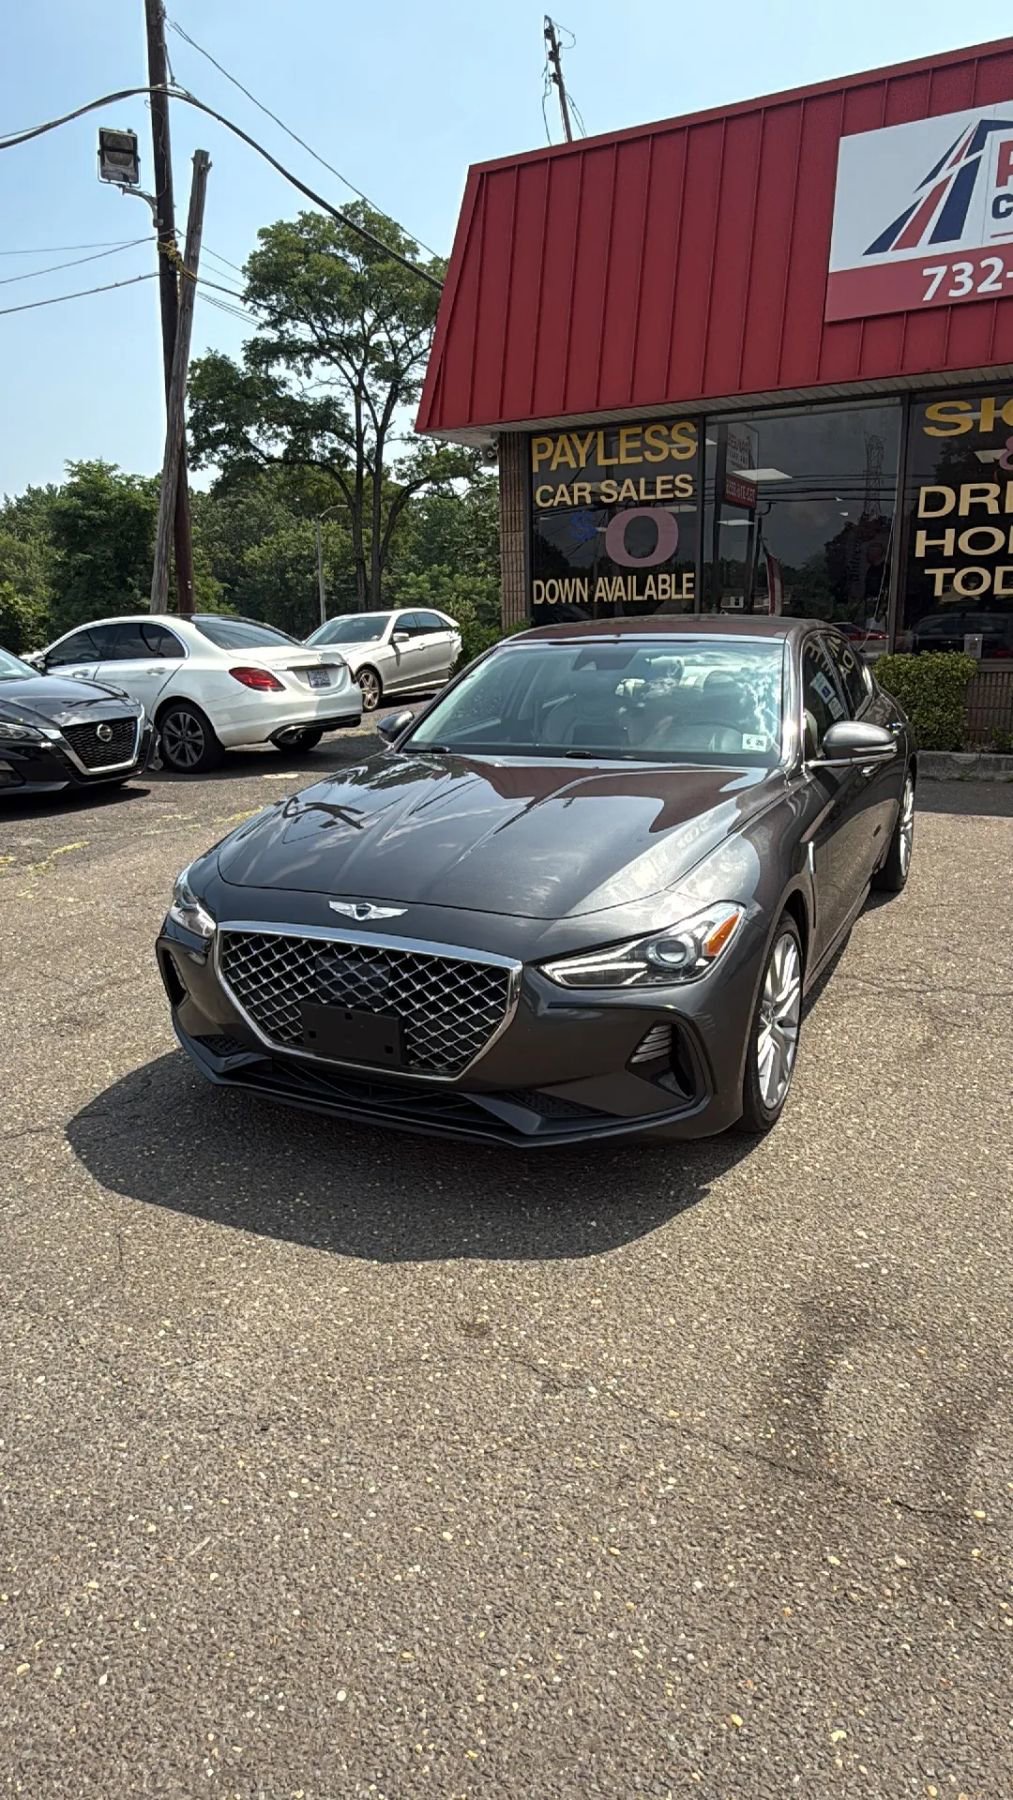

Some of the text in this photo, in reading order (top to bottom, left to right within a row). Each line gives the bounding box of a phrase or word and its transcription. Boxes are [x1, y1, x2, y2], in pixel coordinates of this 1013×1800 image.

[531, 421, 698, 473] PAYLESS
[535, 482, 592, 508] CAR
[600, 473, 694, 504] SALES
[915, 525, 1013, 558] HO
[533, 572, 695, 605] DOWN AVAILABLE
